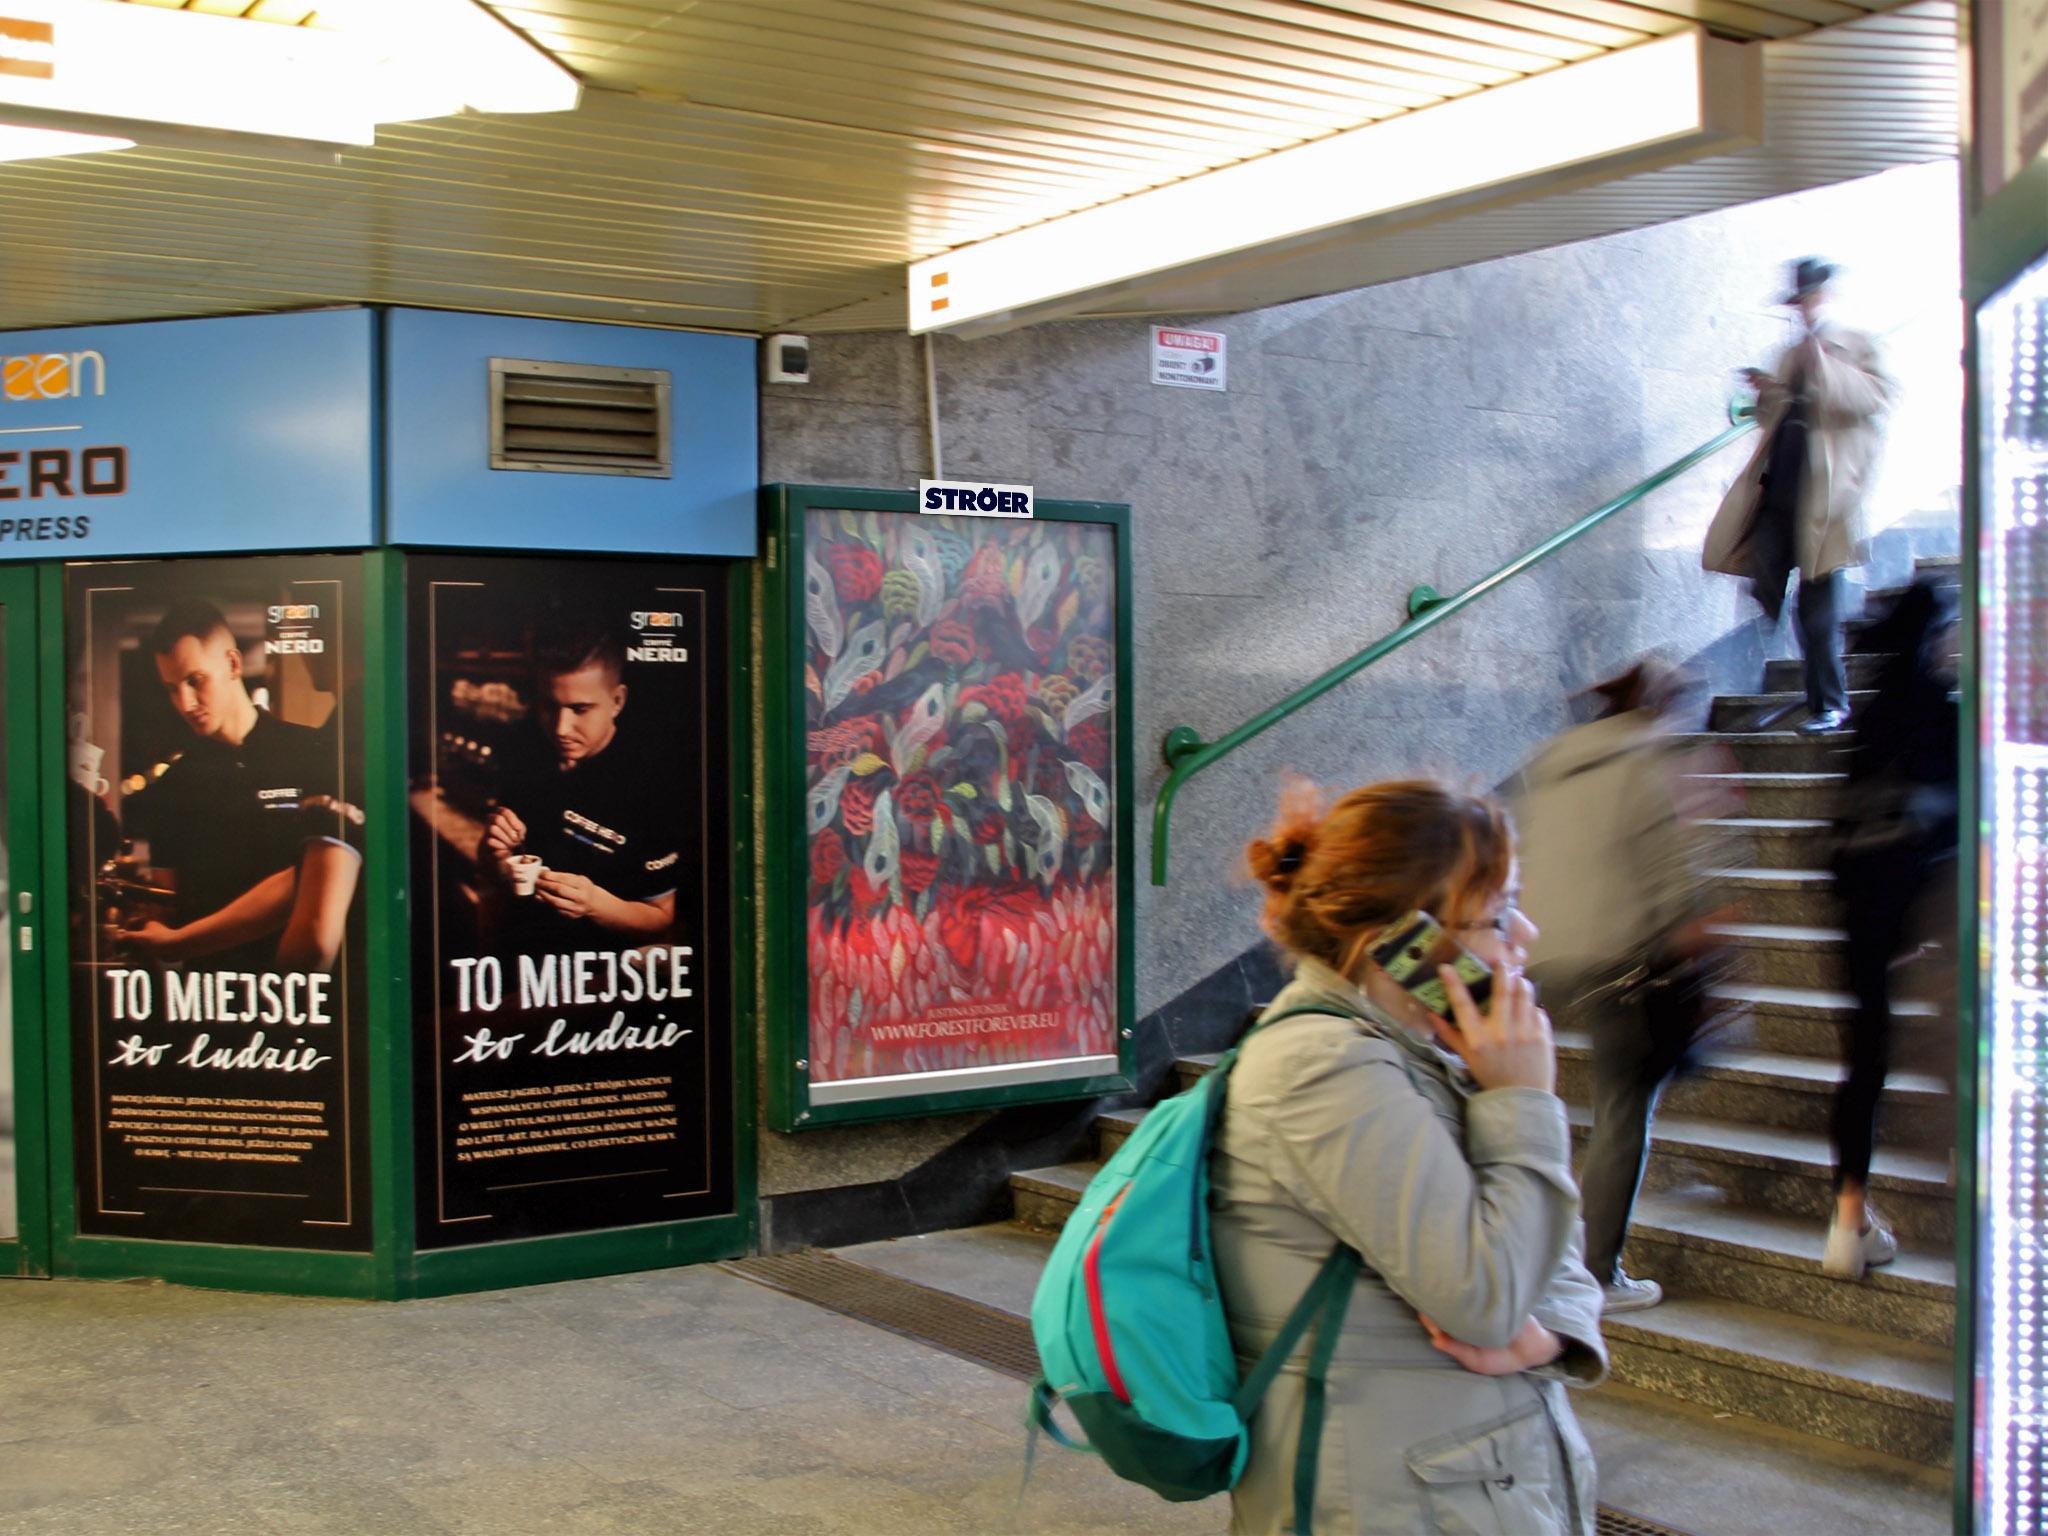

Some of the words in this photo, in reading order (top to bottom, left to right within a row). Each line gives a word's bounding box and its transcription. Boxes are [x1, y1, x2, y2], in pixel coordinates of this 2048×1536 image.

[1164, 333, 1214, 351] UWAGA!
[925, 487, 1030, 514] STRÖER
[267, 604, 320, 624] green
[630, 611, 684, 630] green
[264, 639, 325, 654] NERO
[626, 647, 688, 662] NERO
[450, 956, 502, 1012] TO
[518, 946, 693, 1010] MIEJSCE
[106, 969, 152, 1020] TO
[164, 970, 332, 1025] MIEJSCE
[452, 1027, 525, 1063] to
[530, 1010, 694, 1057] ludzie
[870, 1012, 1061, 1041] WWW.FORESTFOREVER.EU
[108, 1034, 173, 1066] to
[177, 1031, 332, 1072] ludzie
